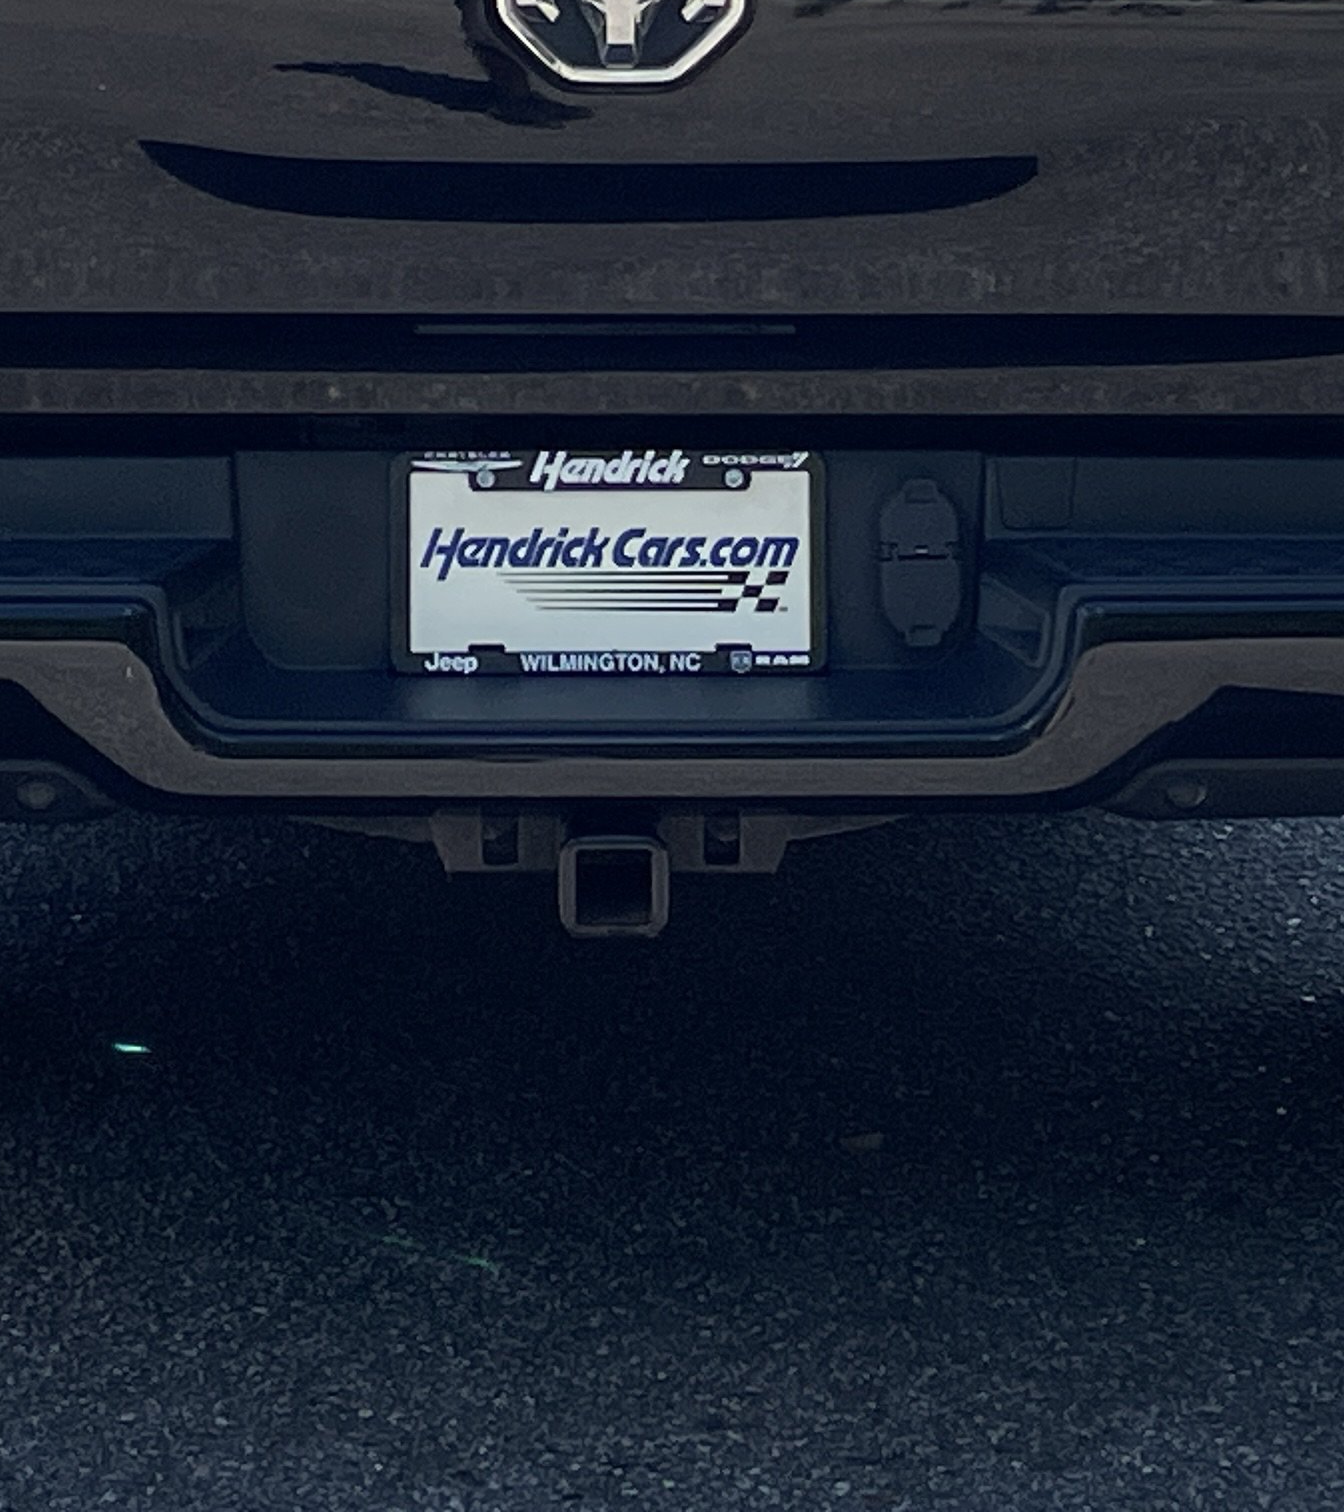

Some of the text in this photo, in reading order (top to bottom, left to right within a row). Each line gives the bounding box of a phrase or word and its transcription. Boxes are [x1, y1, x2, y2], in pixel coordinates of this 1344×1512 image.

[528, 450, 692, 492] Hendrick
[423, 653, 479, 674] Jeep
[520, 653, 702, 673] WILMINGTON, NC
